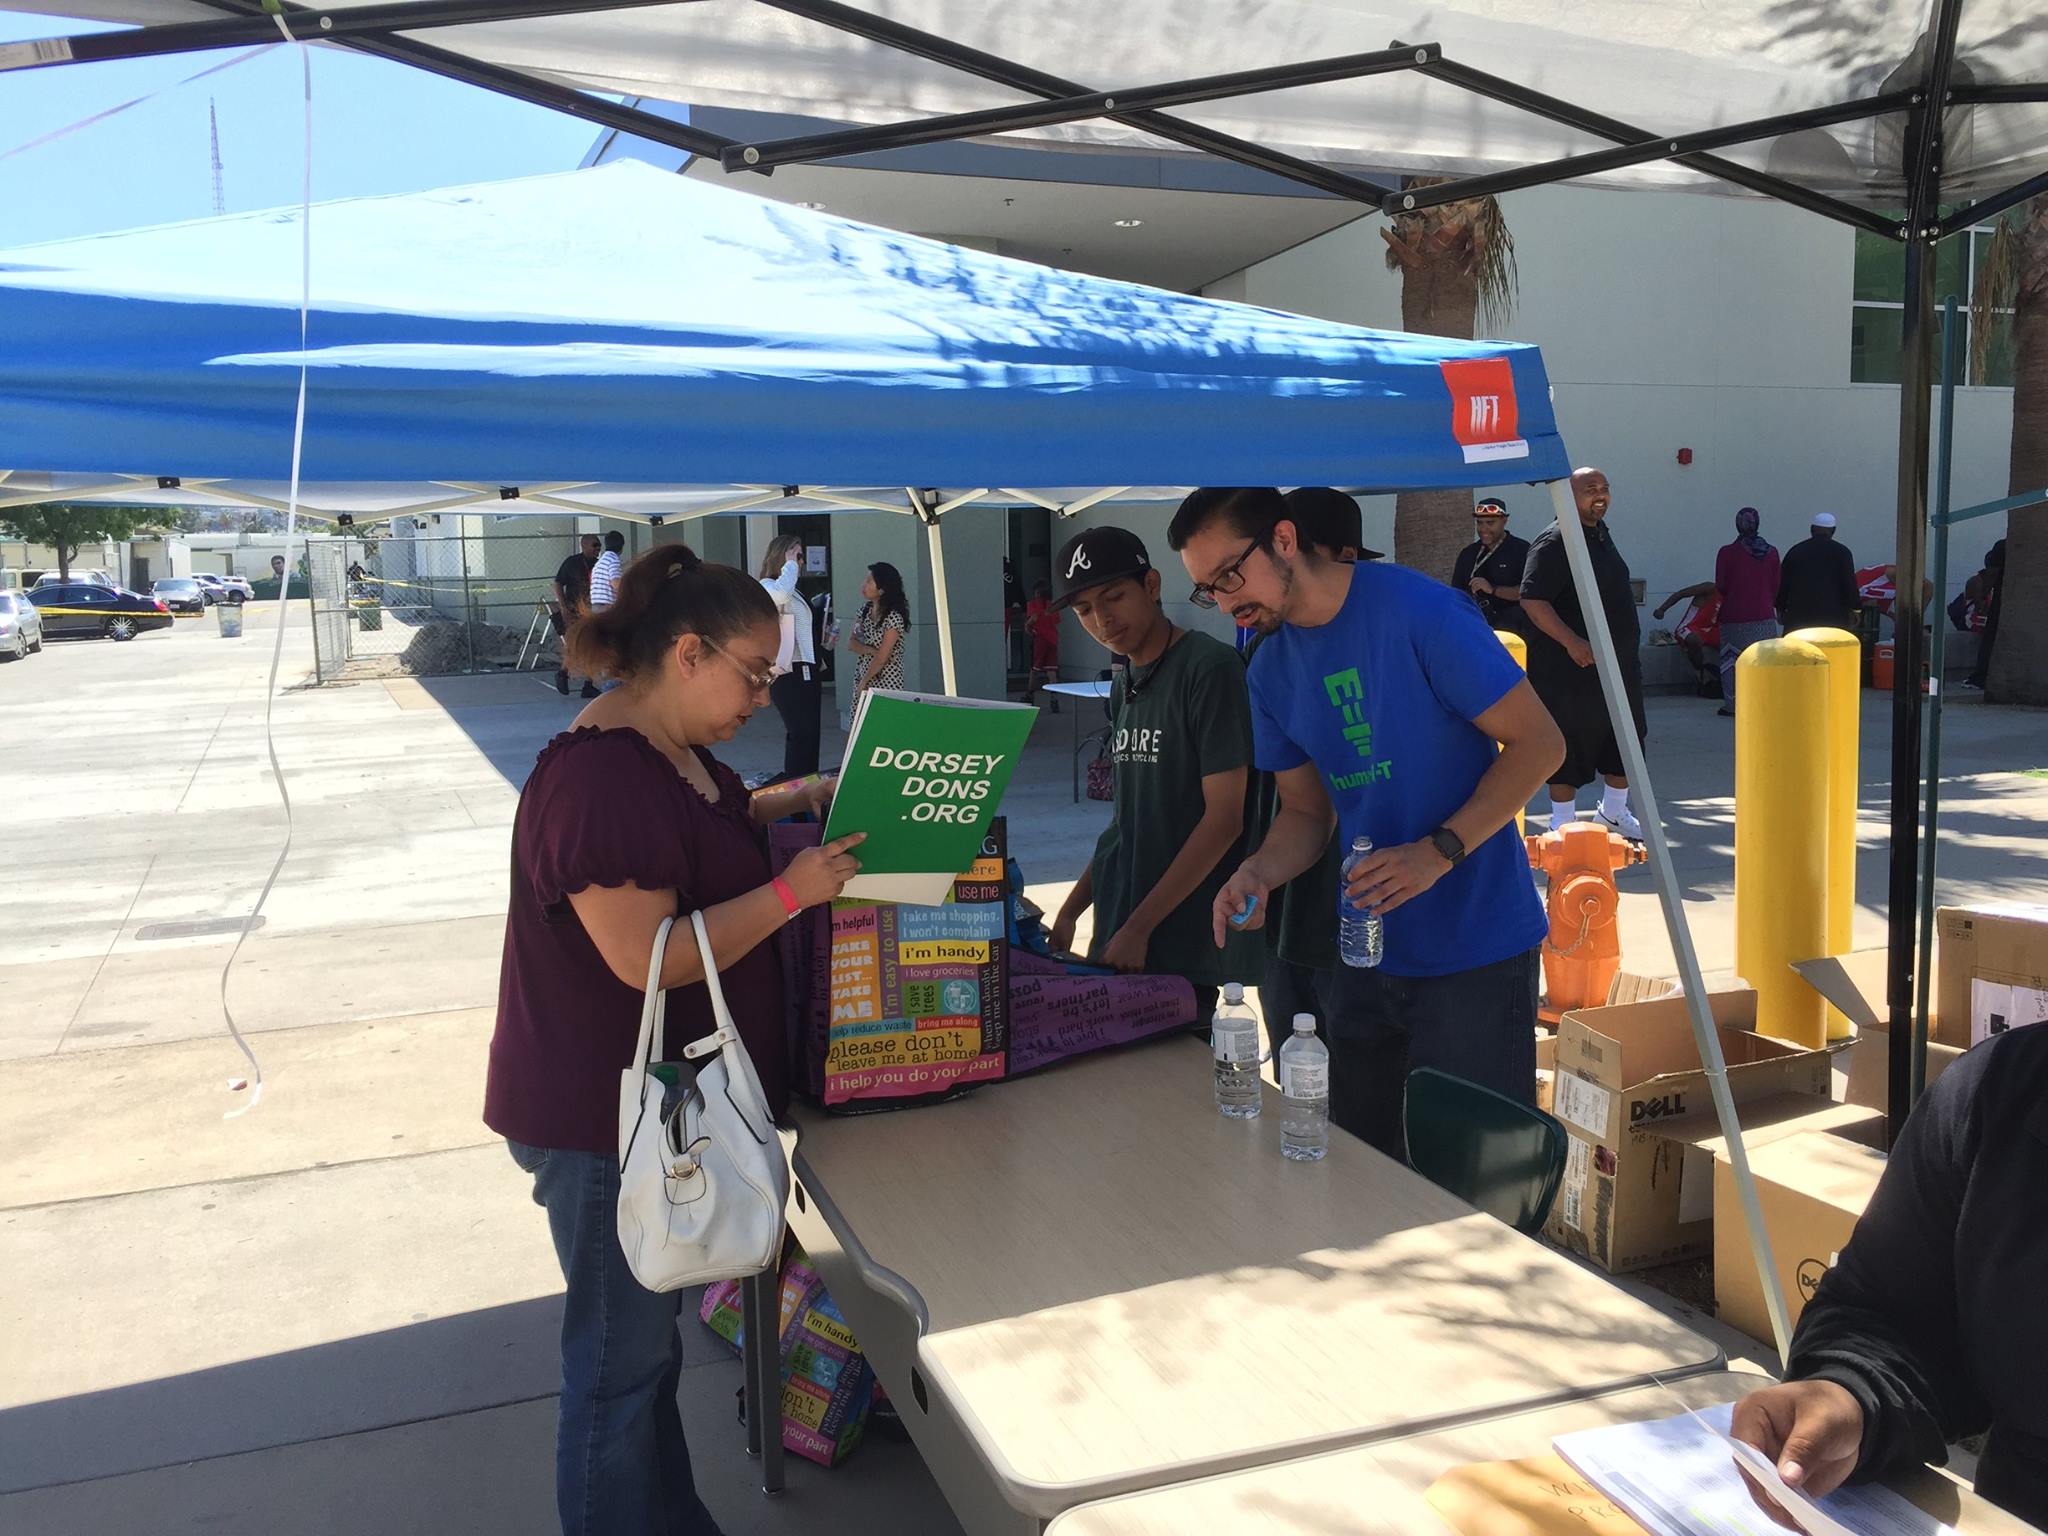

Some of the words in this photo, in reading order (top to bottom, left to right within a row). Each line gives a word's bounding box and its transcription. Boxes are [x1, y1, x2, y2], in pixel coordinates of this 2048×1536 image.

[1470, 395, 1500, 436] HFT
[1065, 543, 1092, 579] A
[869, 746, 1005, 775] DORSEY
[901, 776, 991, 800] DONS
[901, 802, 980, 824] .ORG
[978, 835, 998, 855] G
[957, 885, 979, 900] use
[981, 884, 1000, 899] me
[842, 914, 875, 931] helpful
[882, 910, 894, 932] use
[903, 910, 928, 922] take
[930, 911, 948, 922] me
[909, 925, 939, 939] won't
[942, 926, 991, 940] complain
[831, 940, 870, 955] TAKE
[883, 938, 895, 953] to
[905, 947, 931, 960] i'm
[936, 945, 986, 961] handy
[992, 943, 1000, 961] car
[831, 955, 873, 969] YOUR
[910, 967, 931, 978] love
[932, 966, 976, 979] groceries
[885, 960, 900, 988] easy
[991, 965, 1000, 983] the
[831, 985, 872, 1000] TAKE
[981, 967, 991, 1003] doubt
[884, 994, 899, 1016] i'm
[910, 985, 920, 1008] save
[923, 984, 935, 1014] trees
[1047, 985, 1109, 1011] partners
[832, 1000, 873, 1021] ME
[983, 1005, 992, 1017] in
[992, 1002, 1001, 1019] me
[851, 1023, 883, 1034] reduce
[885, 1019, 912, 1031] waste
[918, 1018, 939, 1030] bring
[941, 1018, 953, 1028] me
[955, 1015, 979, 1028] along
[1057, 1020, 1084, 1037] hard
[829, 1038, 897, 1064] please
[905, 1031, 964, 1051] don't
[837, 1056, 877, 1072] leave
[882, 1053, 906, 1065] me
[911, 1051, 928, 1063] at
[934, 1047, 978, 1061] home
[839, 1075, 872, 1092] help
[873, 1072, 904, 1088] you
[908, 1069, 929, 1083] do
[968, 1057, 999, 1075] part
[1630, 1093, 1686, 1121] DELL
[823, 1322, 859, 1349] handy
[791, 1406, 818, 1430] home
[782, 1424, 807, 1442] your
[805, 1438, 829, 1456] part
